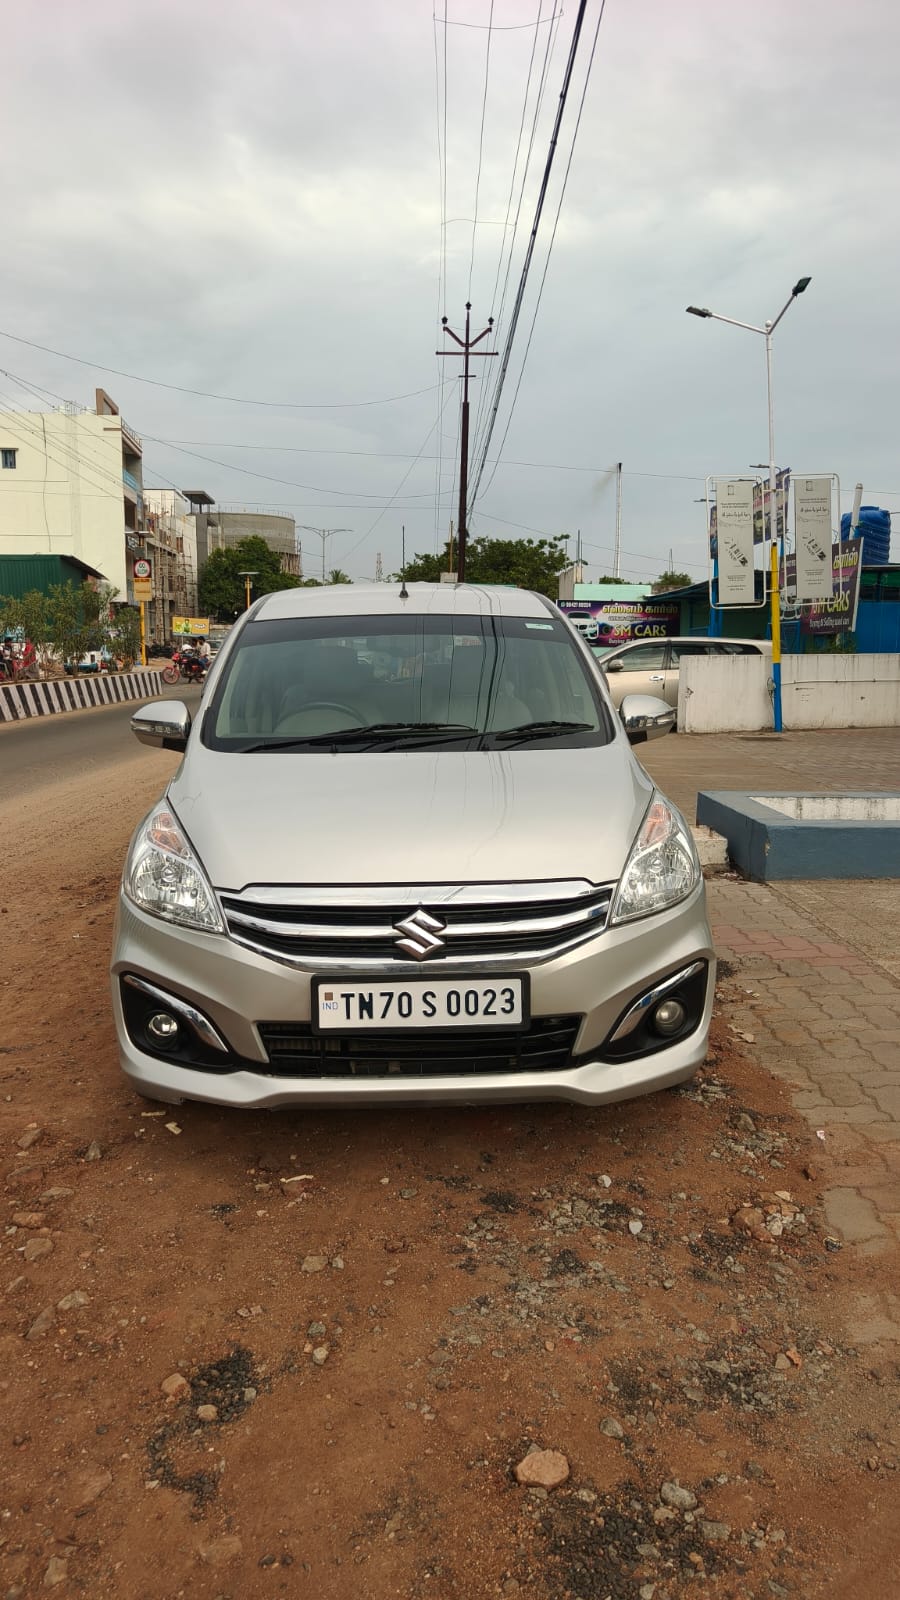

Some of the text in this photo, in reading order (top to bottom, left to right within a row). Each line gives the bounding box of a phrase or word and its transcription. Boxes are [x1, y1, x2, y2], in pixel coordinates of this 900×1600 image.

[614, 624, 666, 637] SM CARS
[322, 1002, 339, 1010] IND
[422, 990, 437, 1017] S
[446, 988, 515, 1017] 0023
